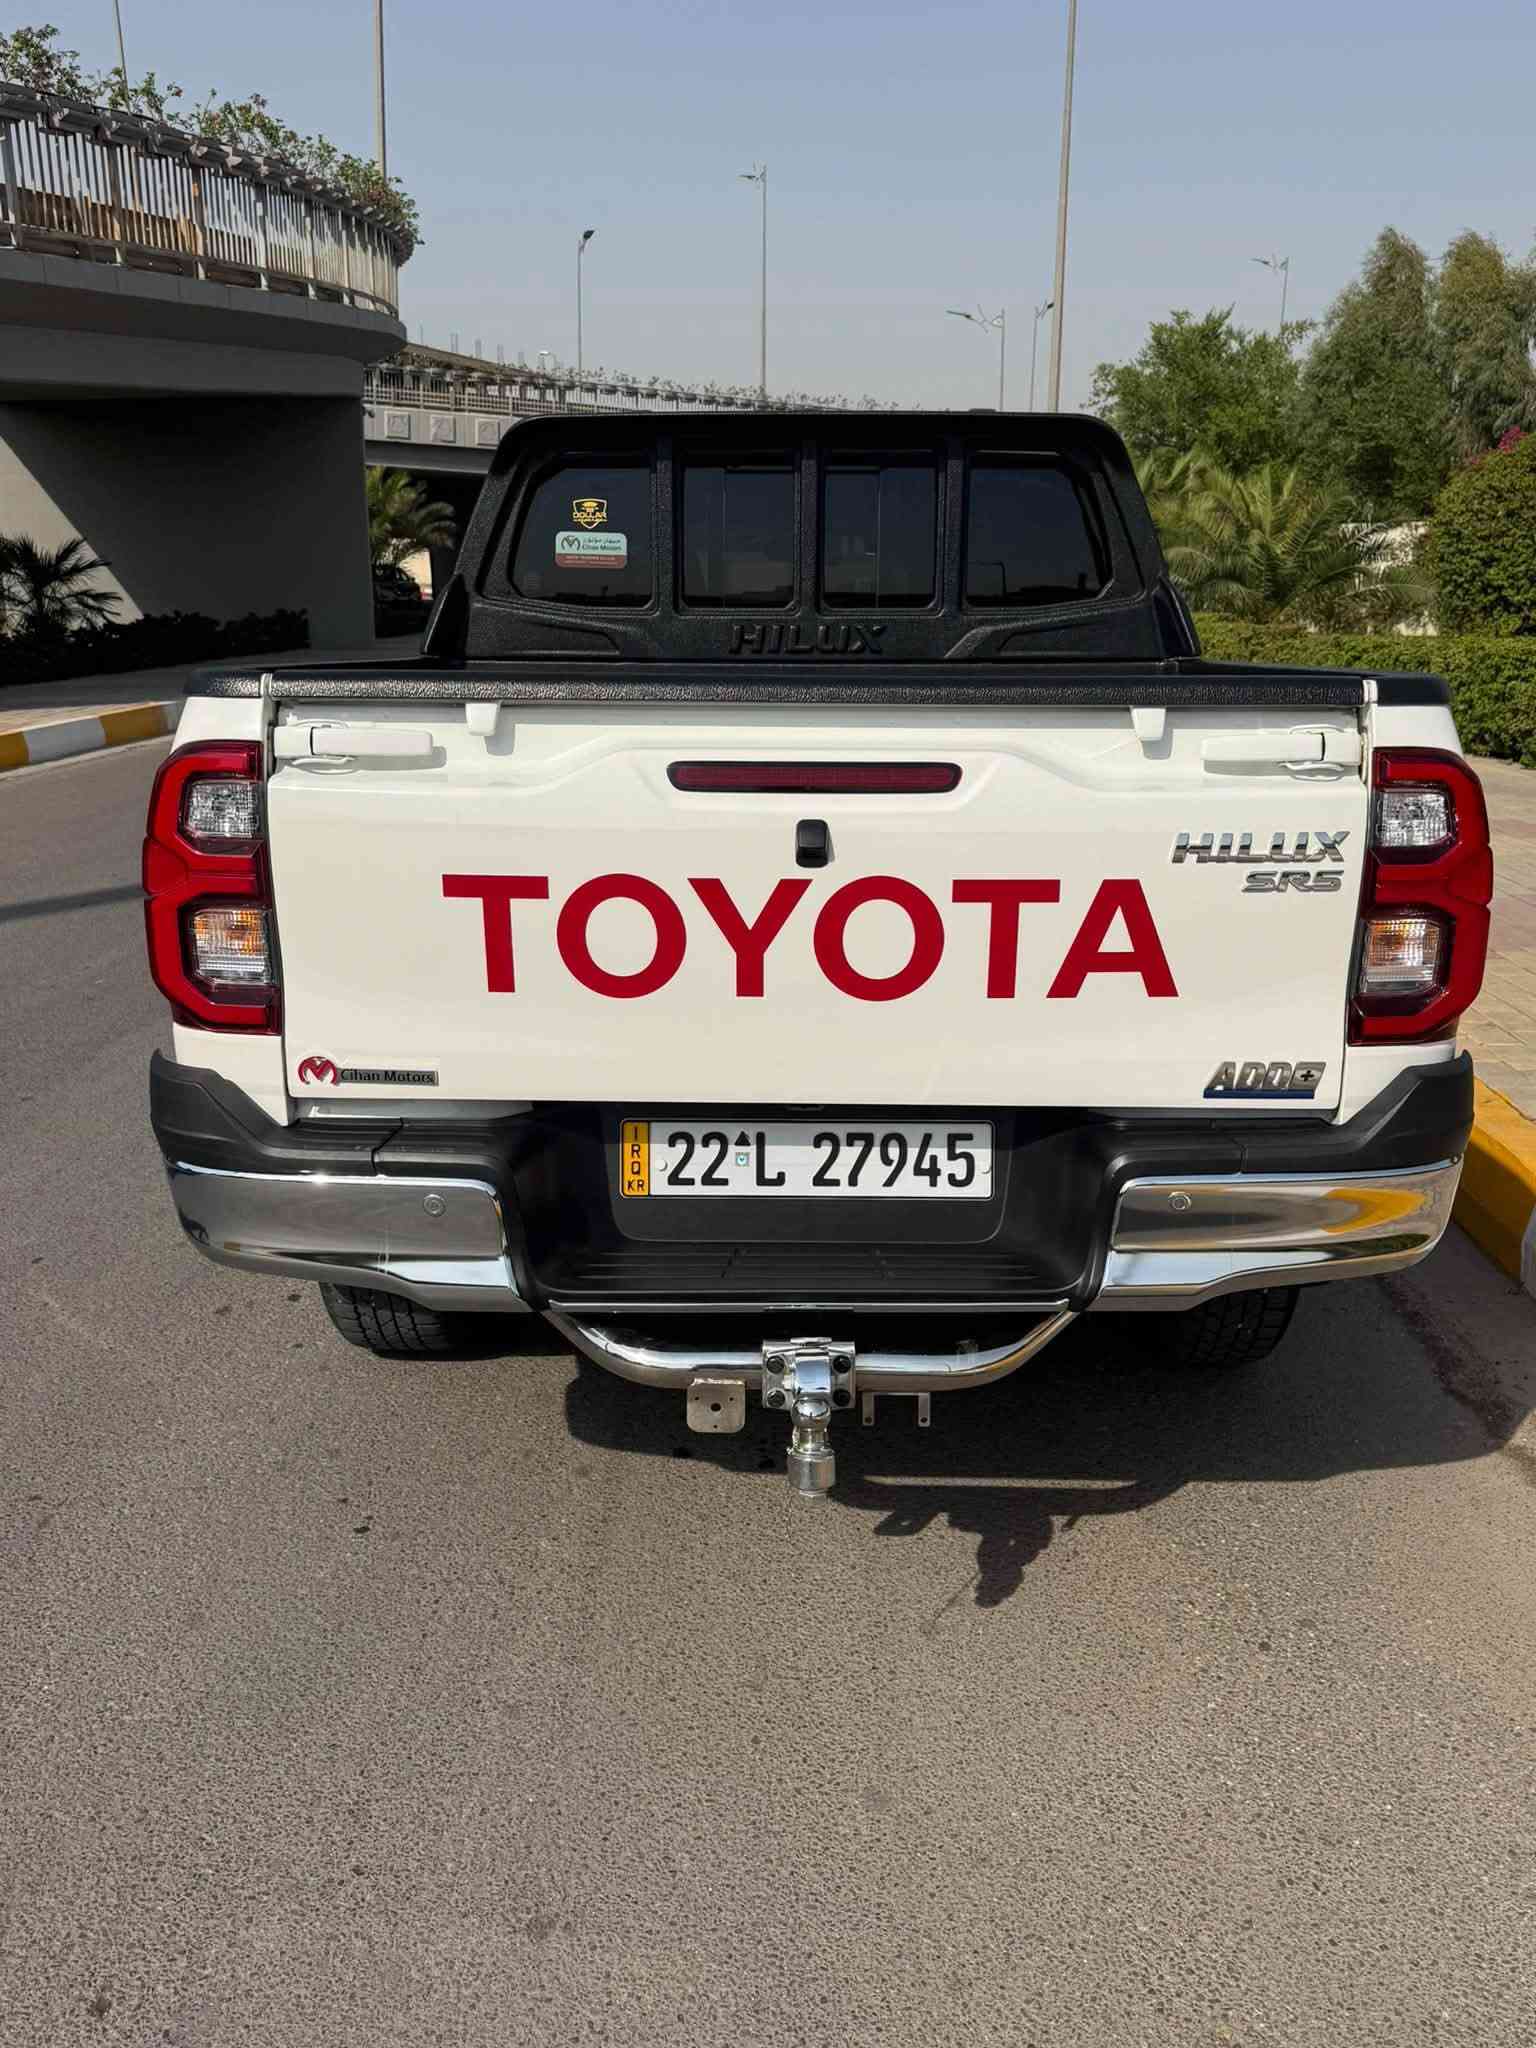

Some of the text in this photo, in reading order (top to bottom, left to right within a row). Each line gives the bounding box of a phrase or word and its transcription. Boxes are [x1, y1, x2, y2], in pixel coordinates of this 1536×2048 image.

[572, 511, 607, 519] DOLLAR
[729, 625, 887, 654] HILUX
[1172, 831, 1349, 863] HILUX
[1241, 870, 1344, 892] SR5
[442, 873, 1179, 1001] TOYOTA
[341, 1068, 435, 1083] Cihan Motors
[667, 1131, 729, 1187] 22
[812, 1132, 975, 1188] 27945
[627, 1179, 645, 1192] KR
